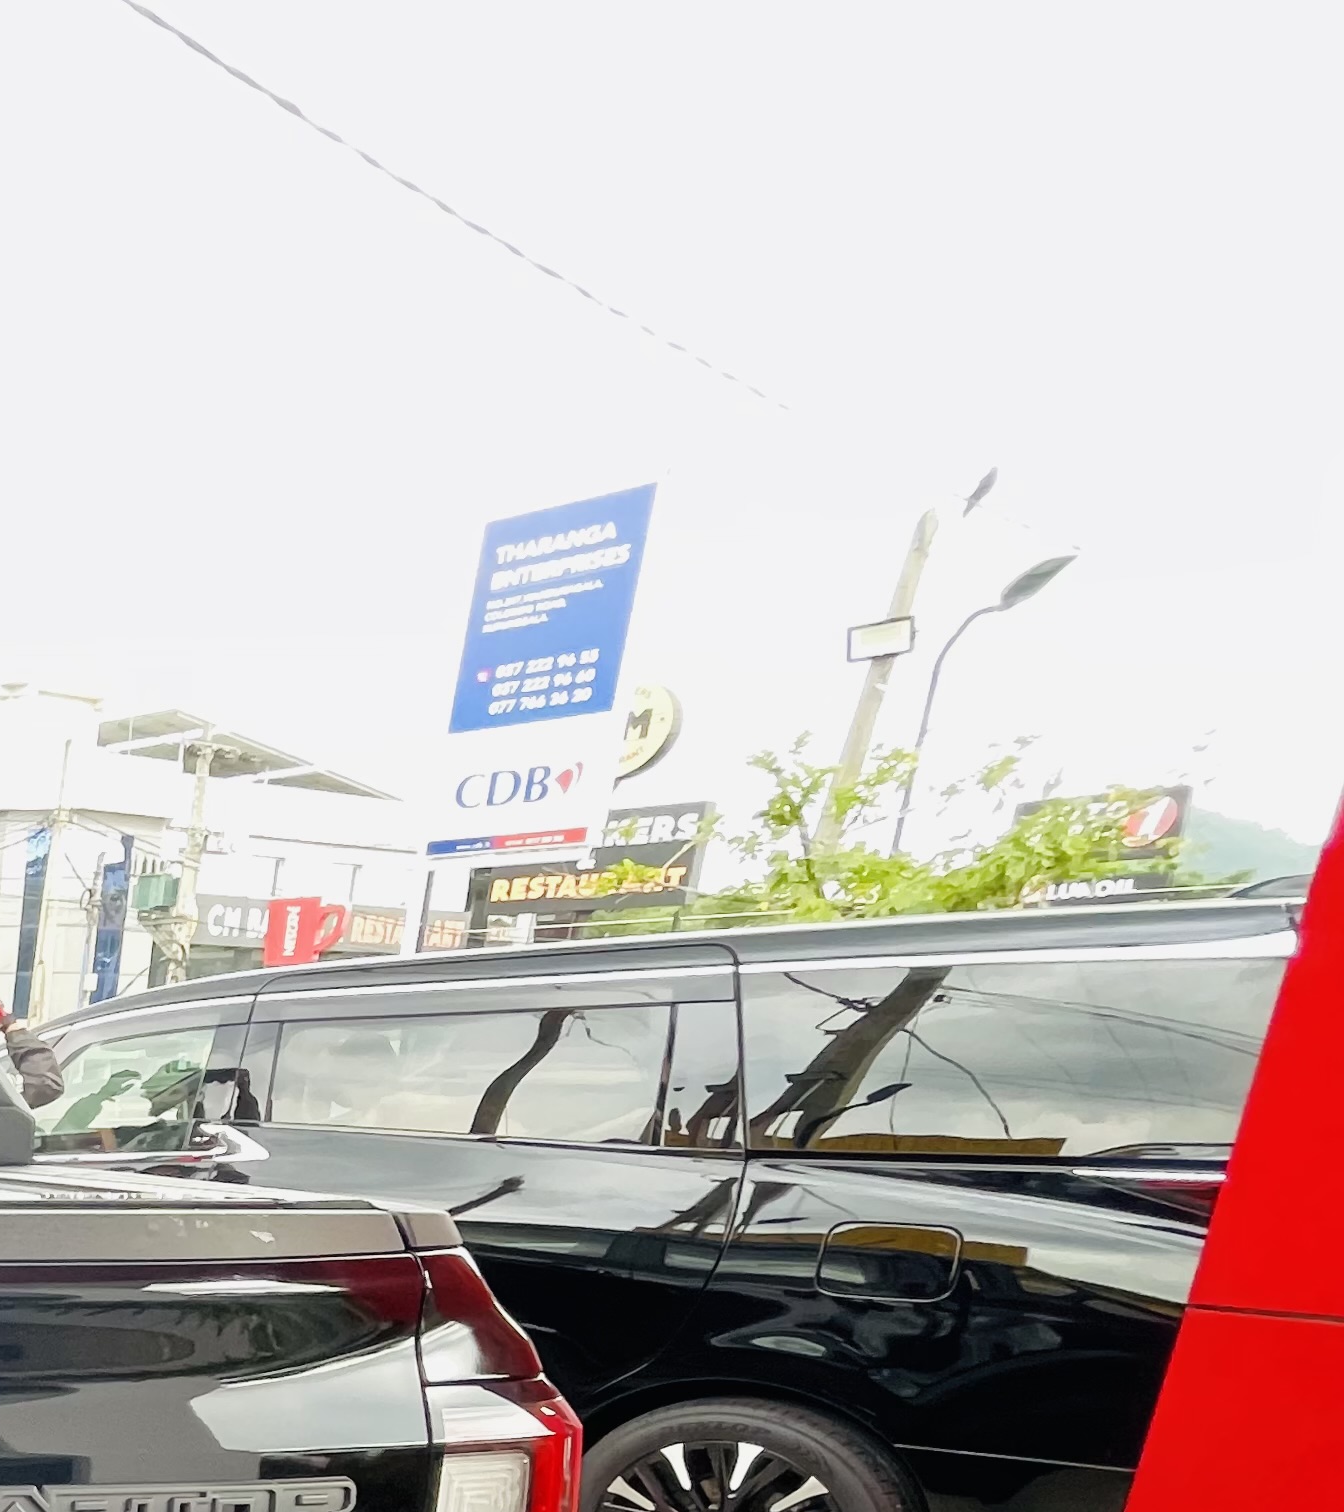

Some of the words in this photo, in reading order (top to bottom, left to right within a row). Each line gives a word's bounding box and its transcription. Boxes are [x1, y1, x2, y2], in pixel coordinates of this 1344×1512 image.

[496, 521, 617, 565] THARANGA
[490, 543, 632, 591] ENTERPRISES
[455, 765, 551, 808] CDB
[604, 812, 700, 848] KERS
